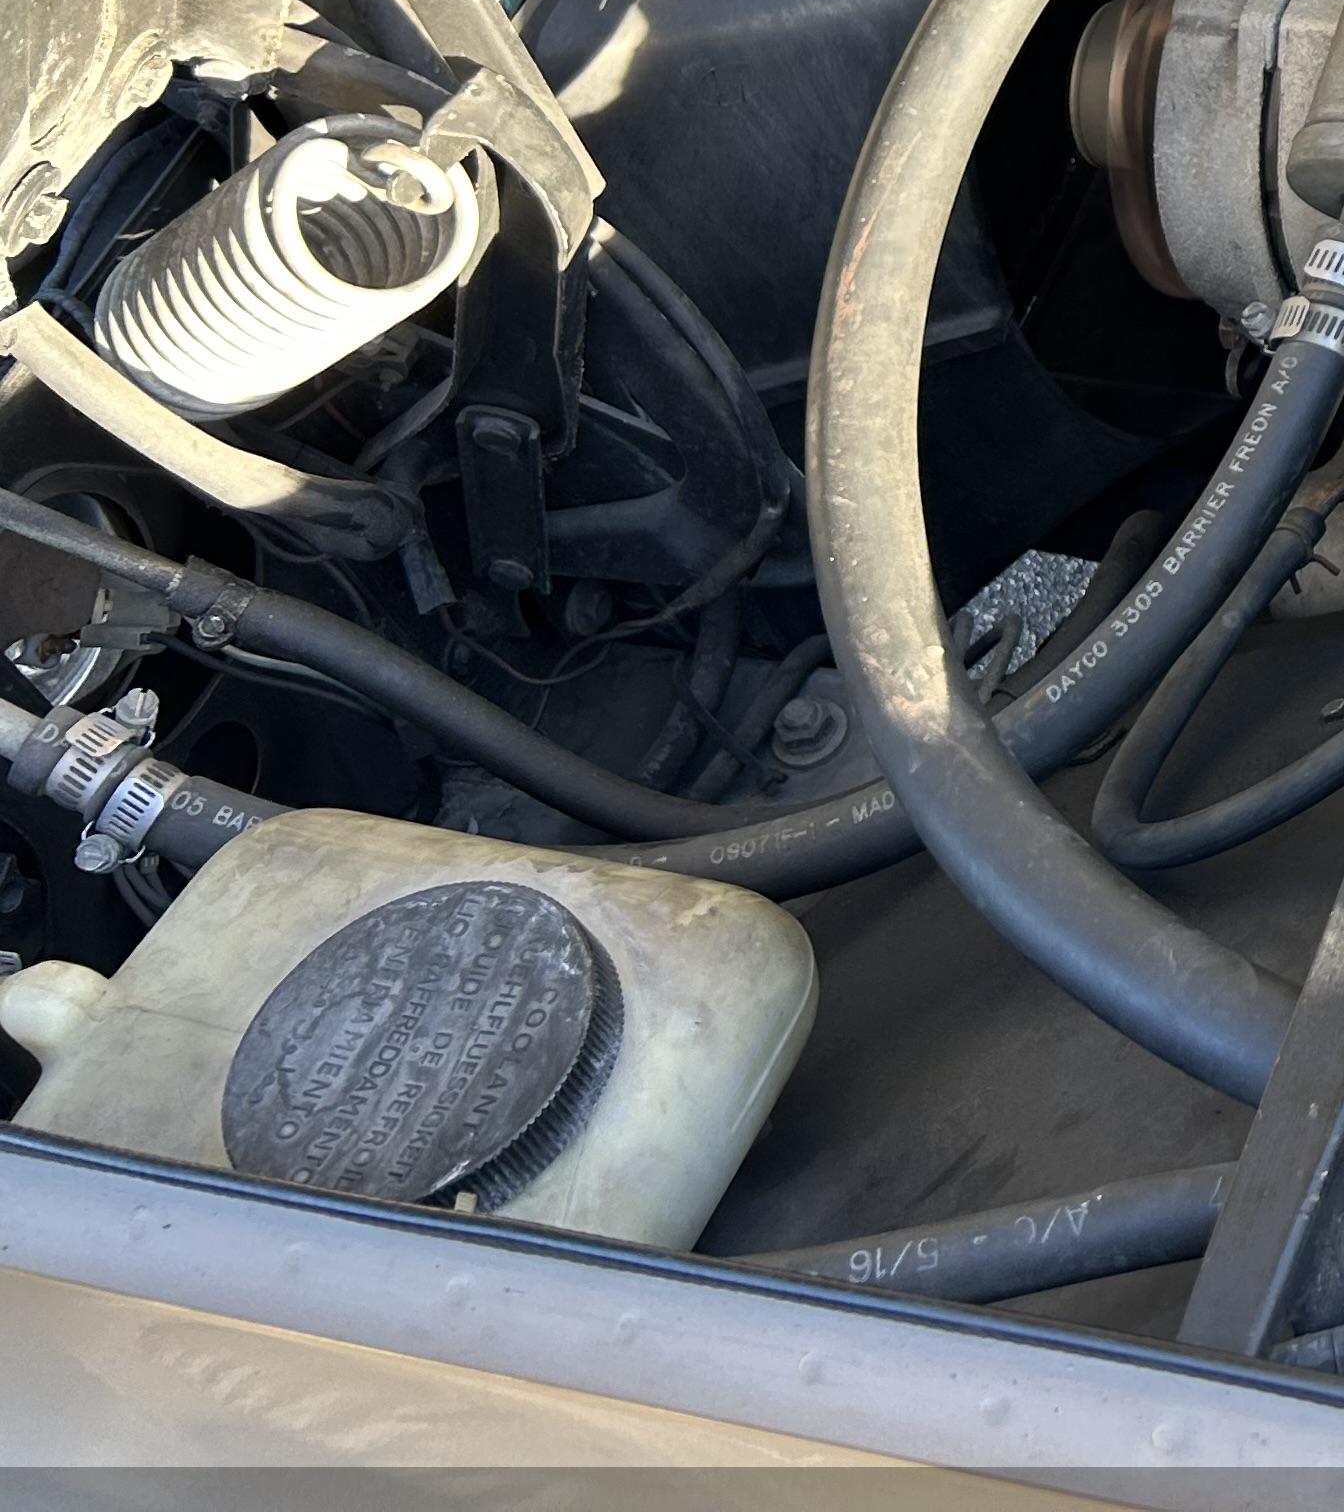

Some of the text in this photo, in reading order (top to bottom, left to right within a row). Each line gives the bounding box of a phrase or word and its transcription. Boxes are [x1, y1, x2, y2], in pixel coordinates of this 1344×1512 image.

[1046, 641, 1107, 703] DAYCO
[1111, 579, 1162, 636] 3305
[1163, 481, 1235, 575] BARRIER
[1229, 403, 1277, 472] FREON
[421, 1031, 452, 1068] DE
[464, 987, 560, 1133] COOLANT
